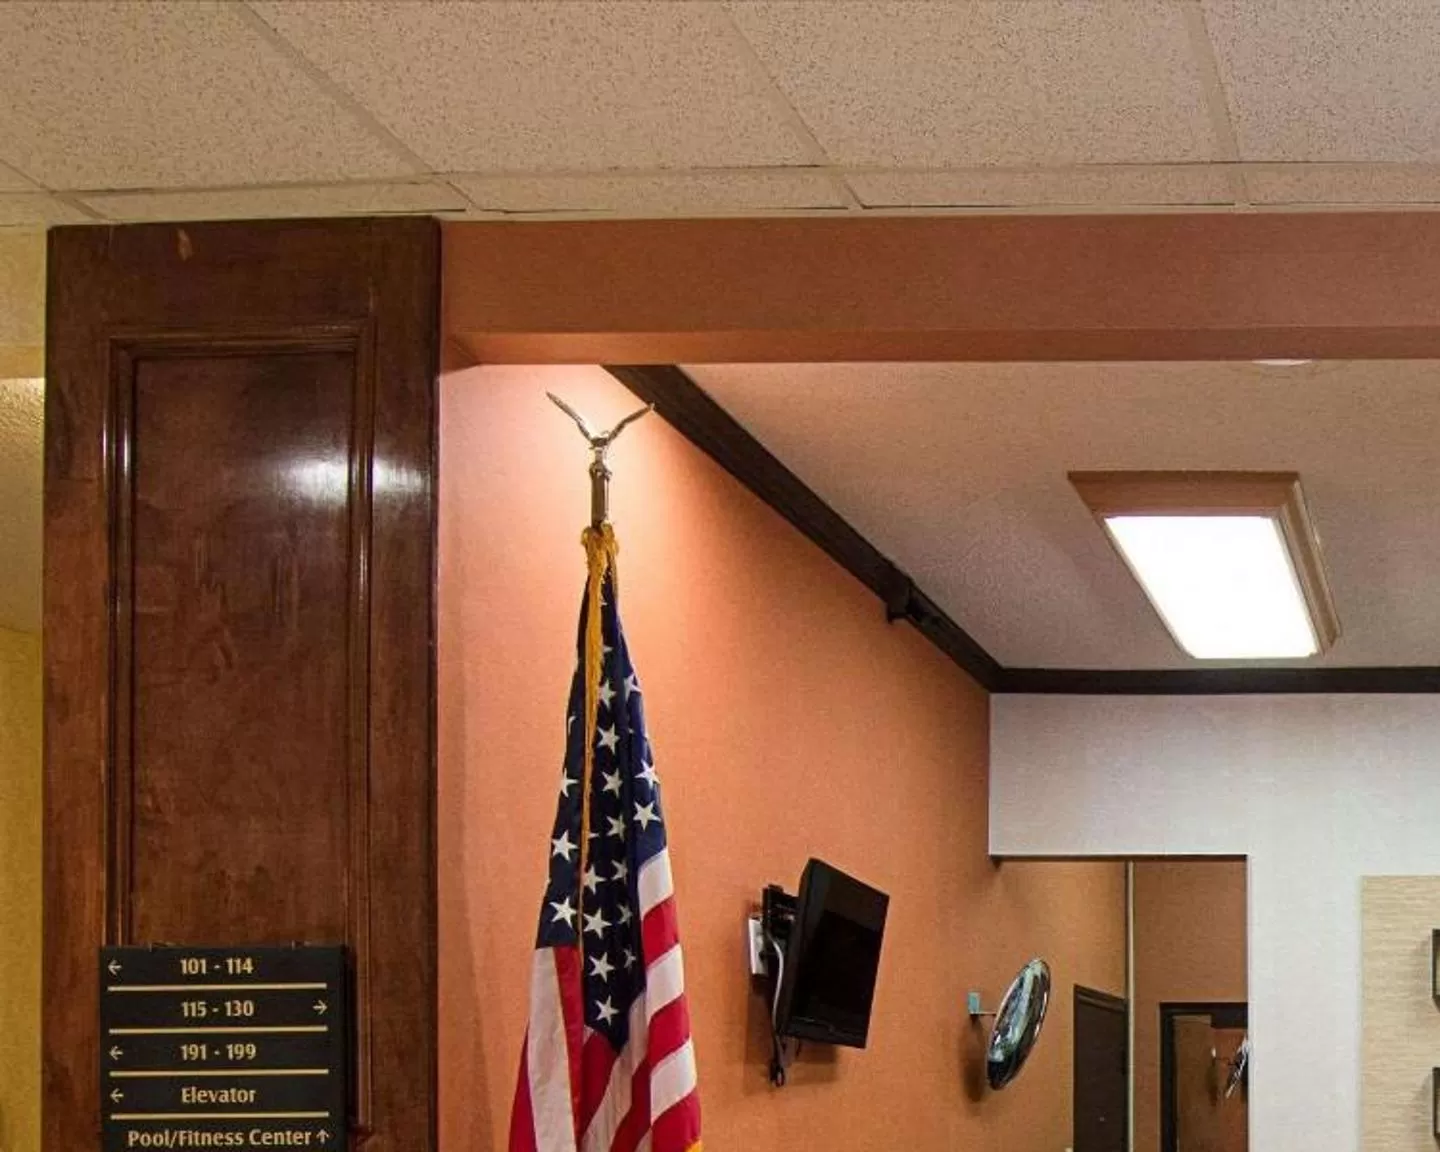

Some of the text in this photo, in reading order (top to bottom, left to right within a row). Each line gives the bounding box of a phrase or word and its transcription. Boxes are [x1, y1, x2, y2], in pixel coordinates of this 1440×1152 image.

[180, 958, 207, 975] 101
[226, 957, 254, 975] 114
[181, 1001, 207, 1017] 115
[224, 999, 255, 1017] 130
[180, 1043, 207, 1061] 191
[226, 1043, 257, 1060] 199
[181, 1086, 256, 1103] Elevator
[127, 1129, 312, 1149] Pool/Fitness Center
